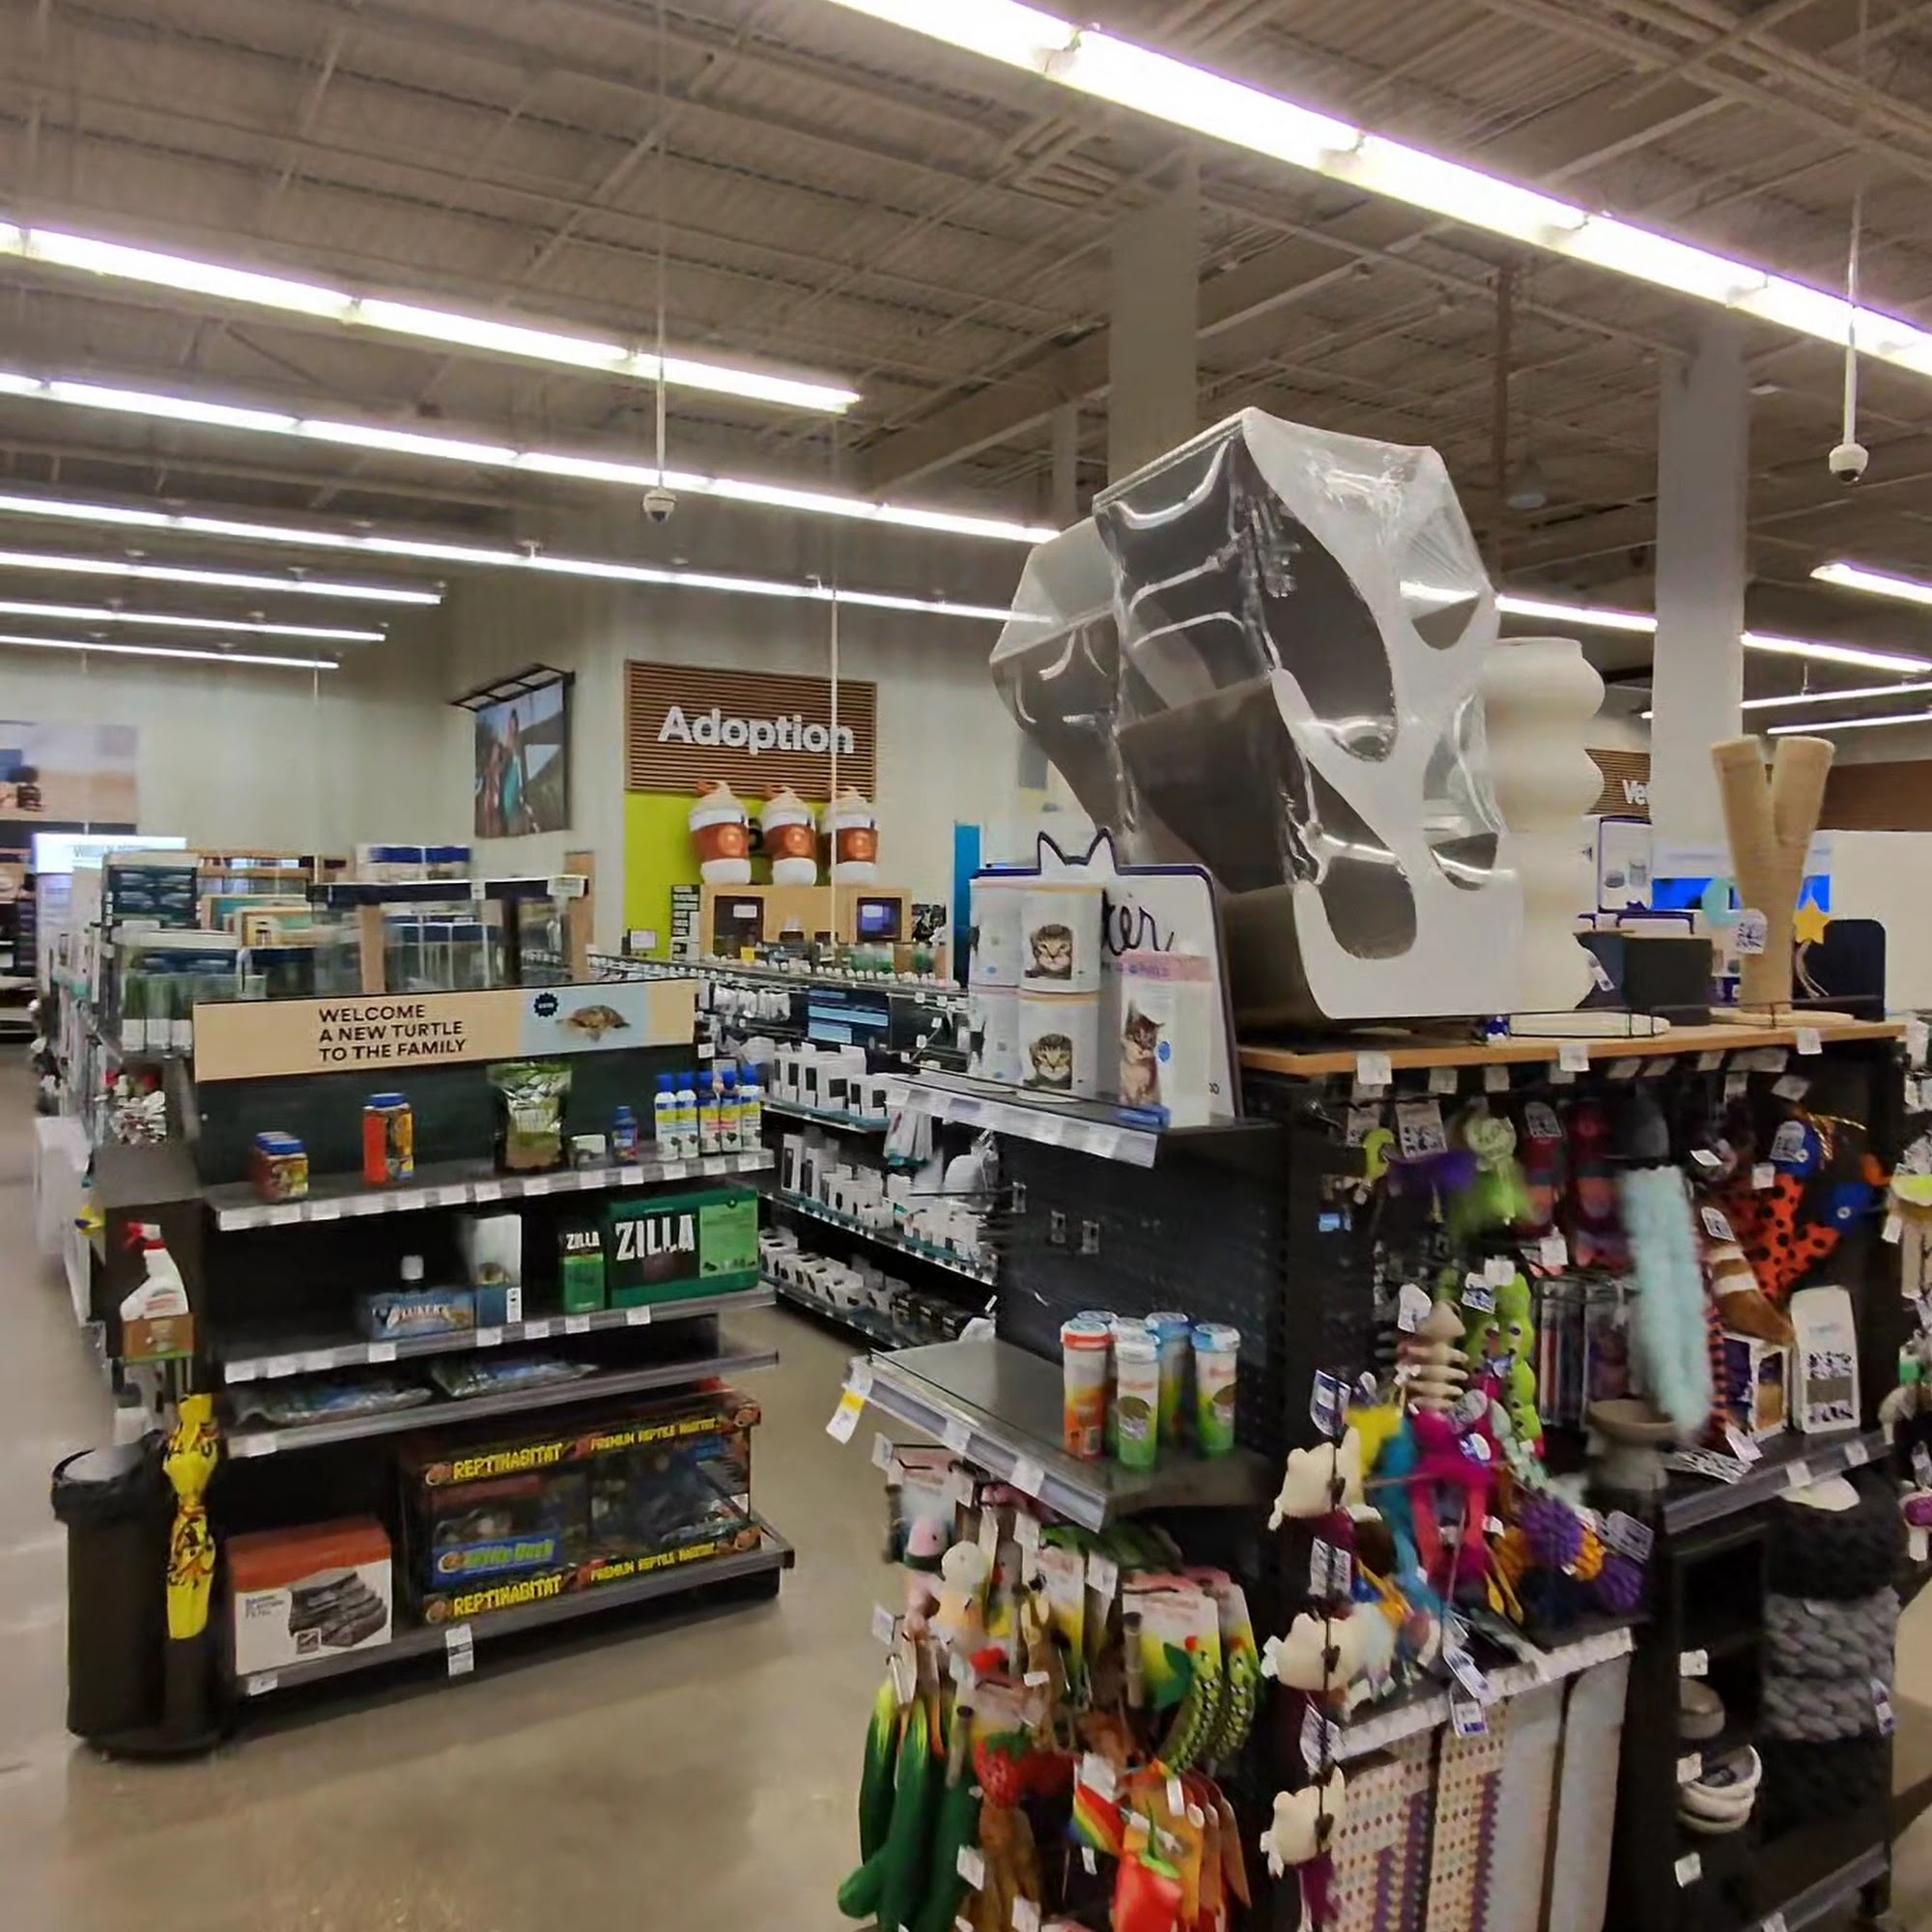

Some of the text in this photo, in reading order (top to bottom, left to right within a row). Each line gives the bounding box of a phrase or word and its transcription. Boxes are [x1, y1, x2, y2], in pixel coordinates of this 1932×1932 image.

[658, 706, 854, 755] Adoption
[319, 1005, 426, 1023] WELCOME
[319, 1021, 464, 1042] A NEW TURTLE
[319, 1038, 467, 1062] TO THE FAMILY
[566, 1232, 601, 1250] ZILLA
[614, 1214, 696, 1262] ZILLA
